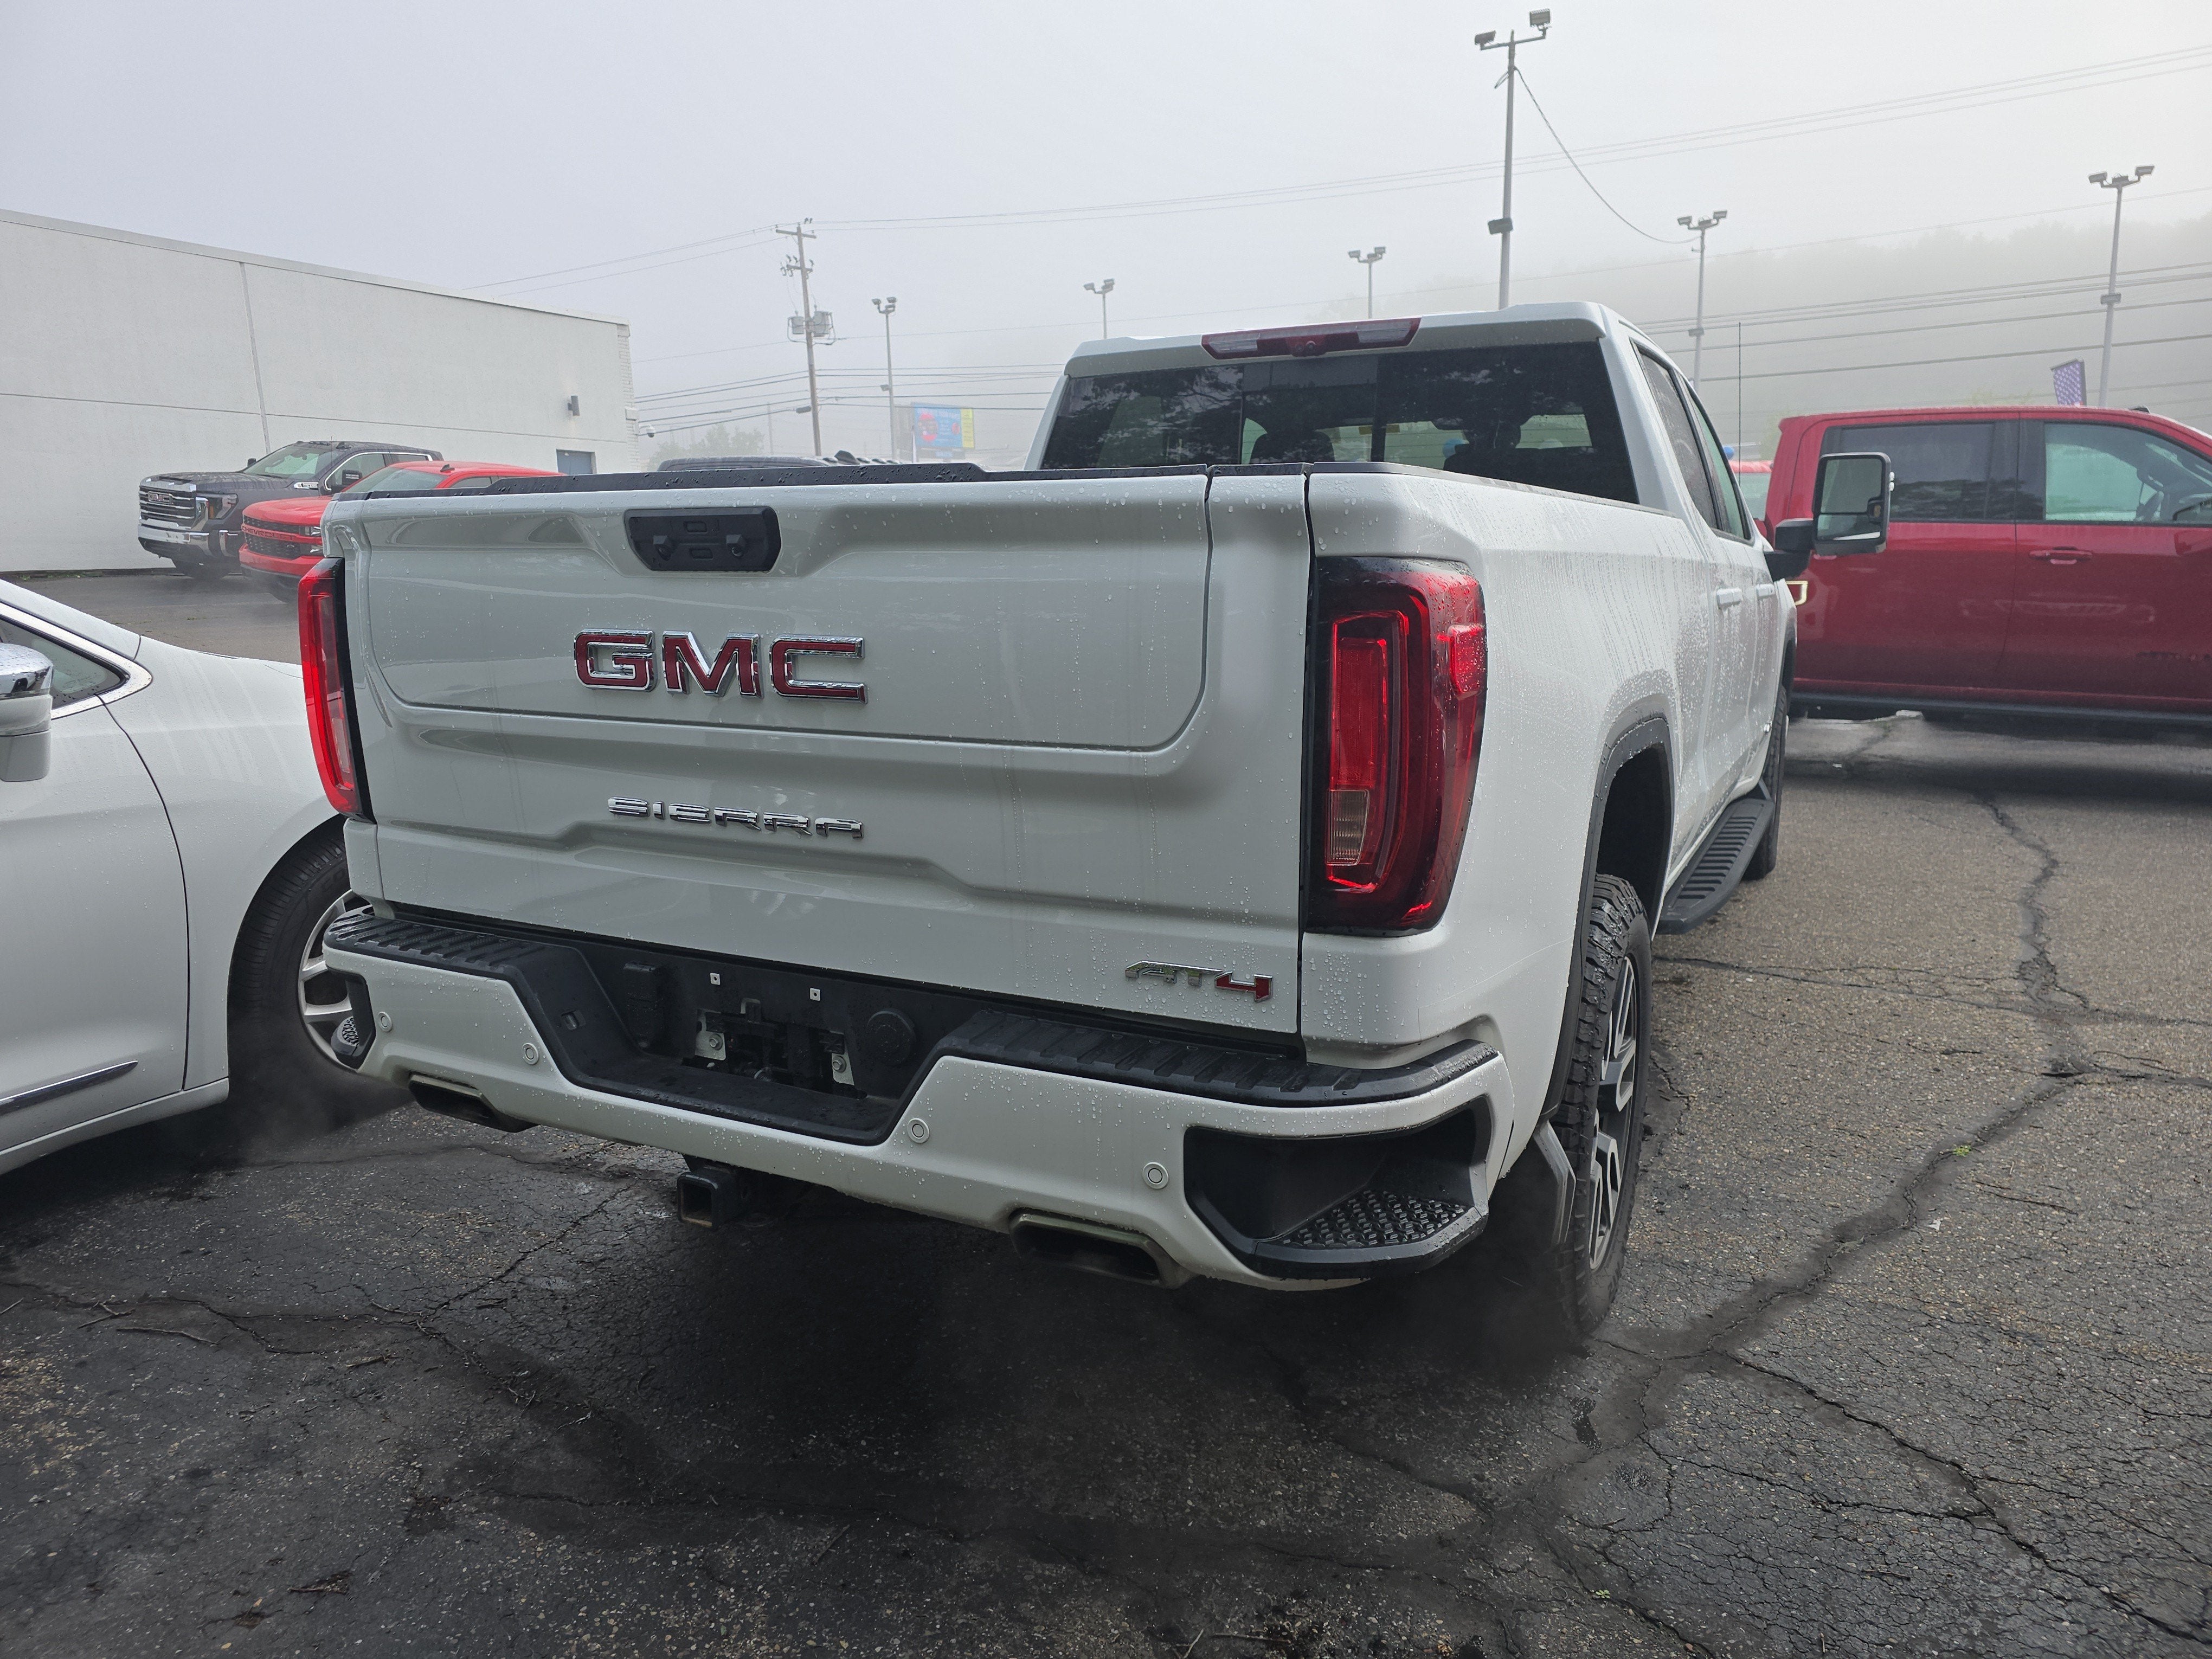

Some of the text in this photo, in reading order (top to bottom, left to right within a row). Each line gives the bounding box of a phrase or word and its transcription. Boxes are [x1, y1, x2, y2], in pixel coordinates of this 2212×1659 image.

[242, 525, 296, 541] CHEVROLET
[574, 628, 868, 704] GMC
[608, 796, 864, 840] SIERRA
[1125, 960, 1273, 1002] AT4
